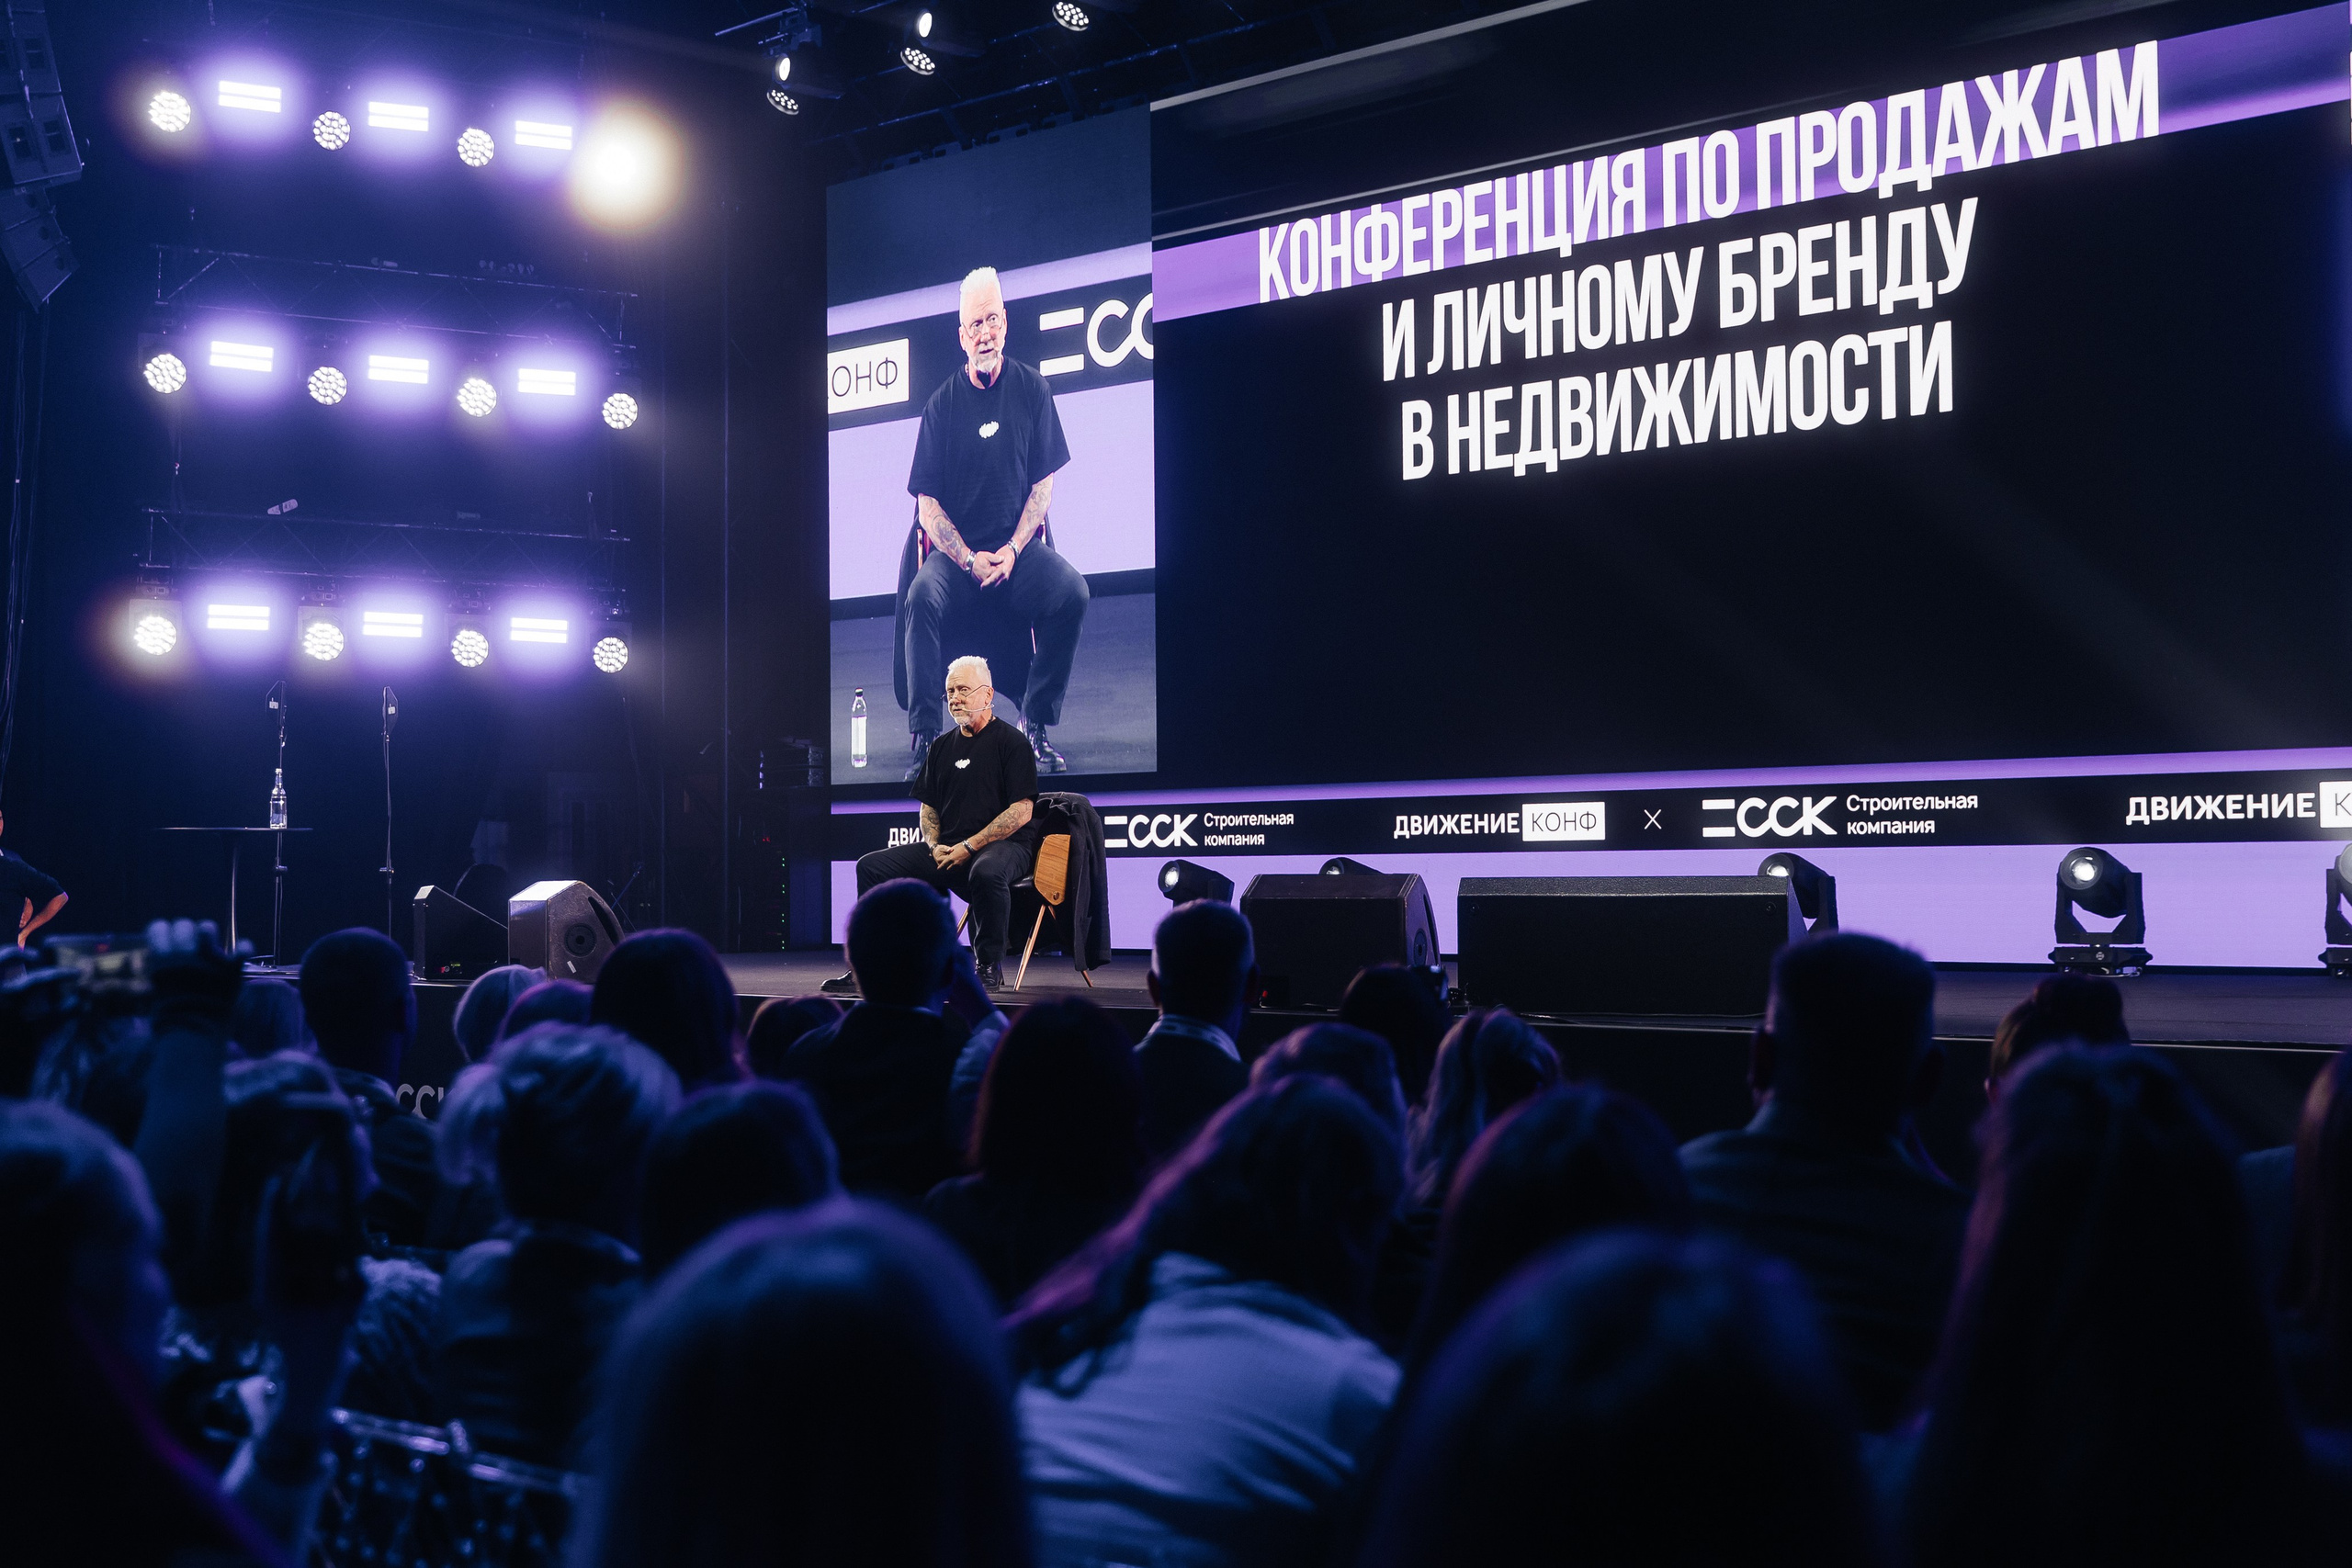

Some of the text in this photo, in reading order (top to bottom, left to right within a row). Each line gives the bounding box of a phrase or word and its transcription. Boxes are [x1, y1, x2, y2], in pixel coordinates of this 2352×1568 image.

[1259, 39, 2159, 304] КОНФЕРЕНЦИЯ ПО ПРОДАЖАМ
[1383, 197, 1978, 382] И ЛИЧНОМУ БРЕНДУ
[828, 356, 899, 399] ОНФ
[1402, 321, 1953, 480] В НЕДВИЖИМОСТИ
[1846, 794, 1978, 815] Строительная
[2125, 792, 2316, 826] ДВИЖЕНИЕ
[1204, 812, 1295, 830] Строительная
[1393, 811, 1597, 840] ДВИЖЕНИЕ КОНФ
[1847, 819, 1935, 835] компания
[888, 828, 925, 848] ДВИ
[1204, 834, 1265, 847] компания
